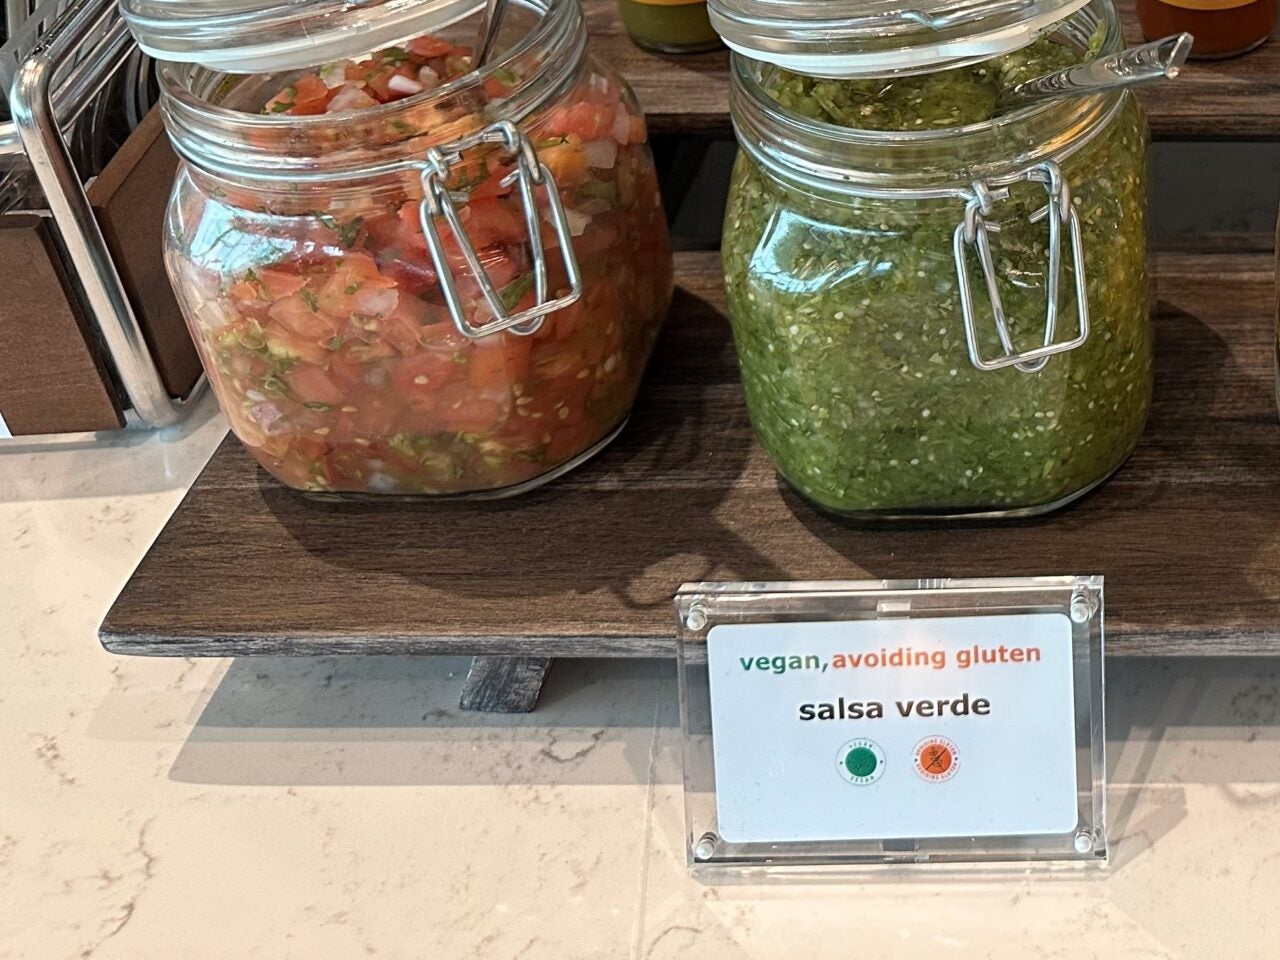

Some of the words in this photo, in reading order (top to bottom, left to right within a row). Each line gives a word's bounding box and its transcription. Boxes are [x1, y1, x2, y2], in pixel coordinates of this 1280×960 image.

[956, 644, 1041, 668] gluten
[799, 697, 883, 721] salsa
[896, 693, 991, 718] verde
